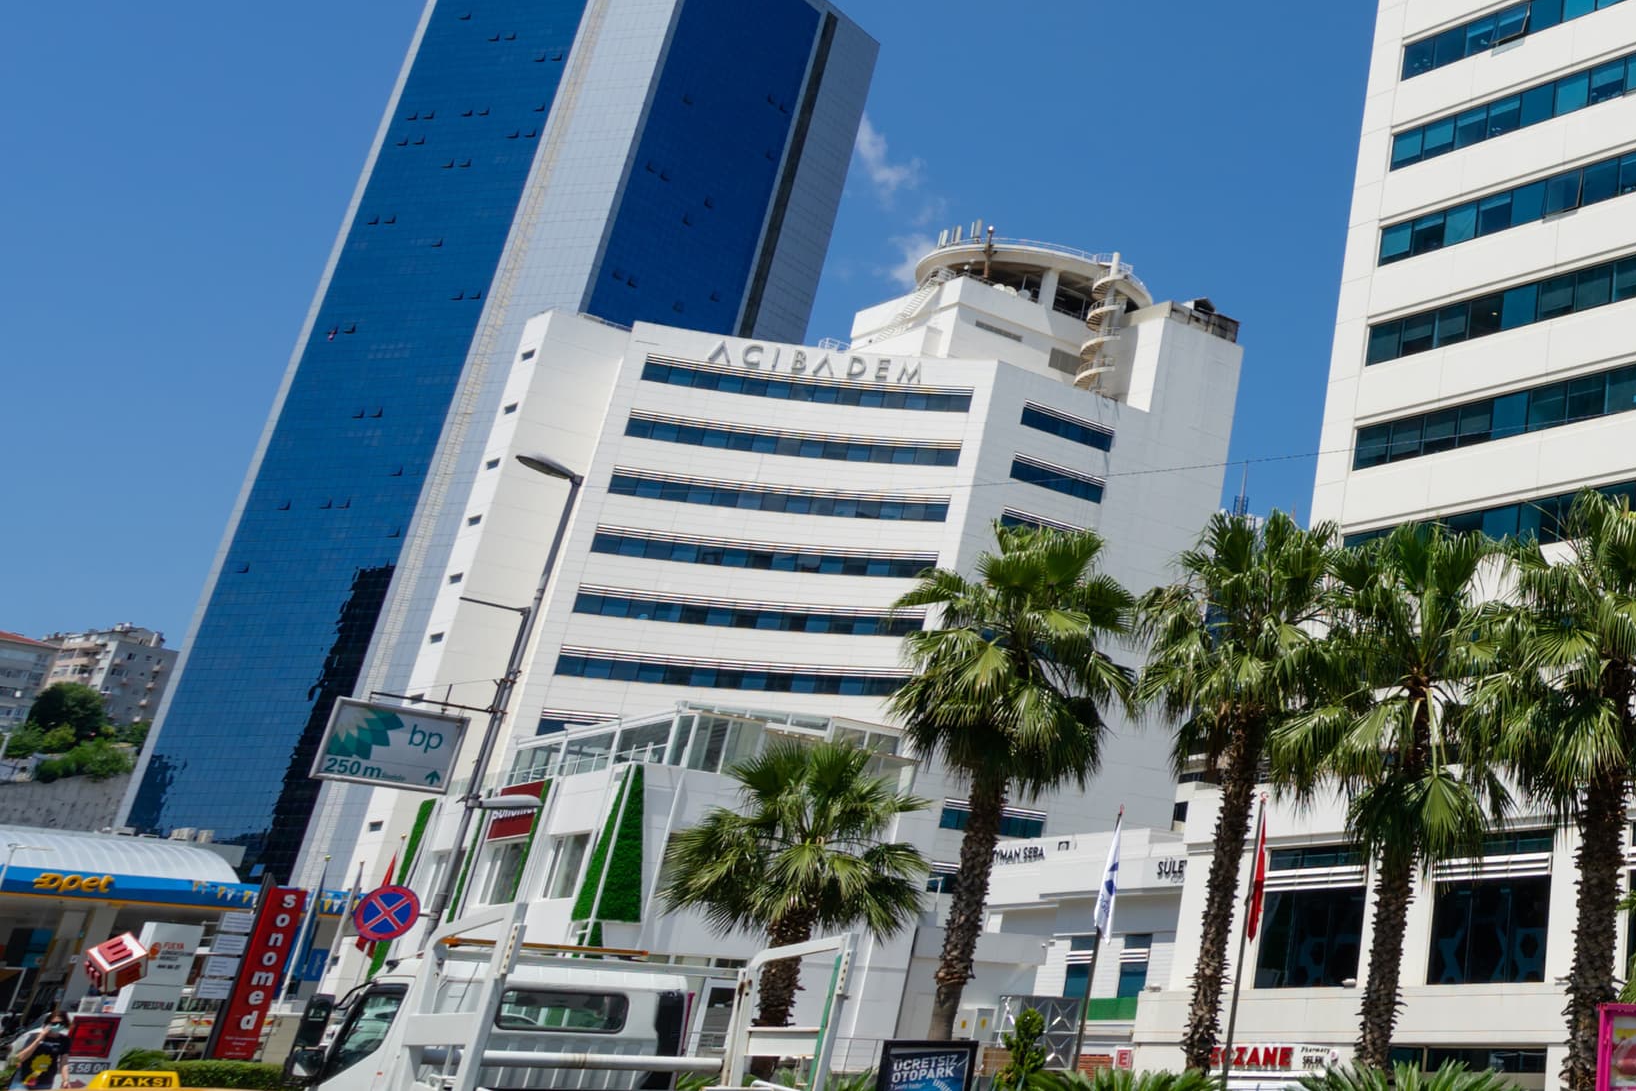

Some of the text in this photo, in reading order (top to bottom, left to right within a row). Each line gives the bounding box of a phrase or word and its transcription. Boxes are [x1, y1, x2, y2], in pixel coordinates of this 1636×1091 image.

[707, 341, 922, 386] ACIBADEM
[407, 723, 444, 754] bp
[323, 757, 362, 776] 250
[362, 764, 383, 779] m
[992, 846, 1045, 862] YMAN SEBA
[239, 893, 298, 1031] sonomed
[1117, 1052, 1128, 1066] E
[1209, 1046, 1294, 1067] ECZANE
[891, 1066, 955, 1084] OTOPARK
